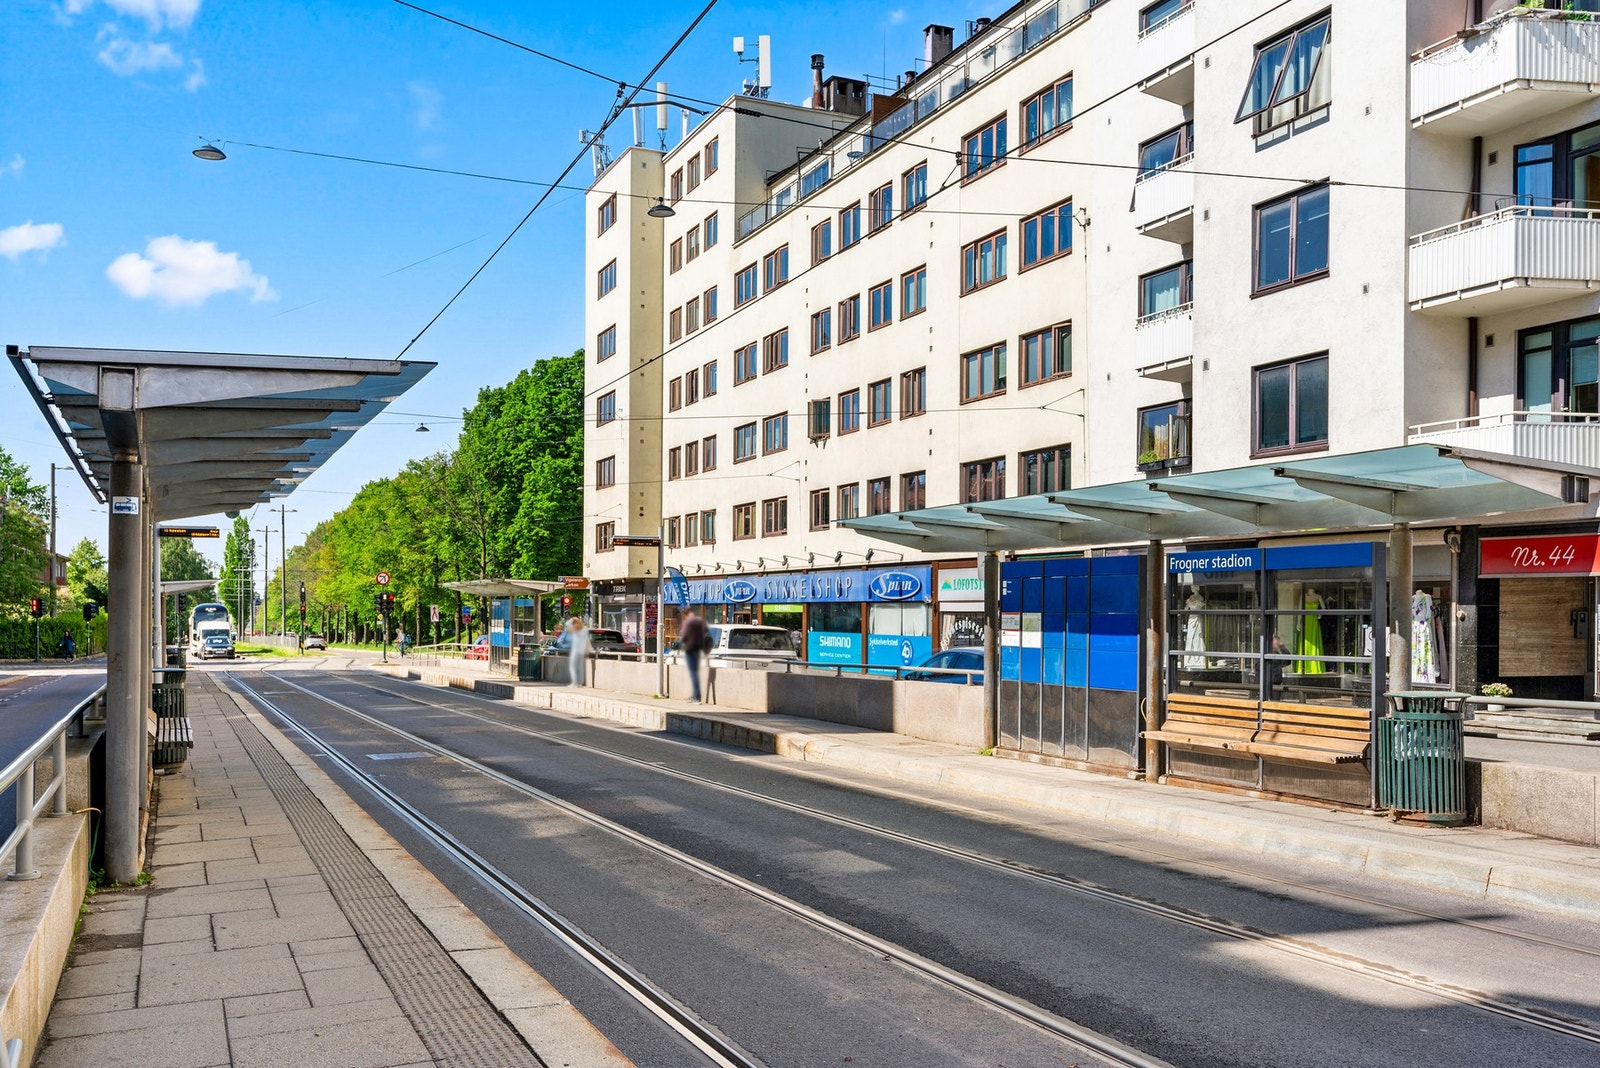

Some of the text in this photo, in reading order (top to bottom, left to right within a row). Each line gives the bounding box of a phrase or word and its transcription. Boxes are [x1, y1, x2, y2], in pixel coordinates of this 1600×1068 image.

[1169, 553, 1252, 573] Frogner stadion
[1510, 544, 1576, 567] Nr. 44
[612, 585, 627, 593] TREK
[727, 581, 751, 599] Spinn
[767, 576, 852, 599] SYKKELSHOP
[876, 572, 913, 596] Spinn
[953, 578, 986, 591] LOFOTST
[819, 635, 852, 649] SHIMANO
